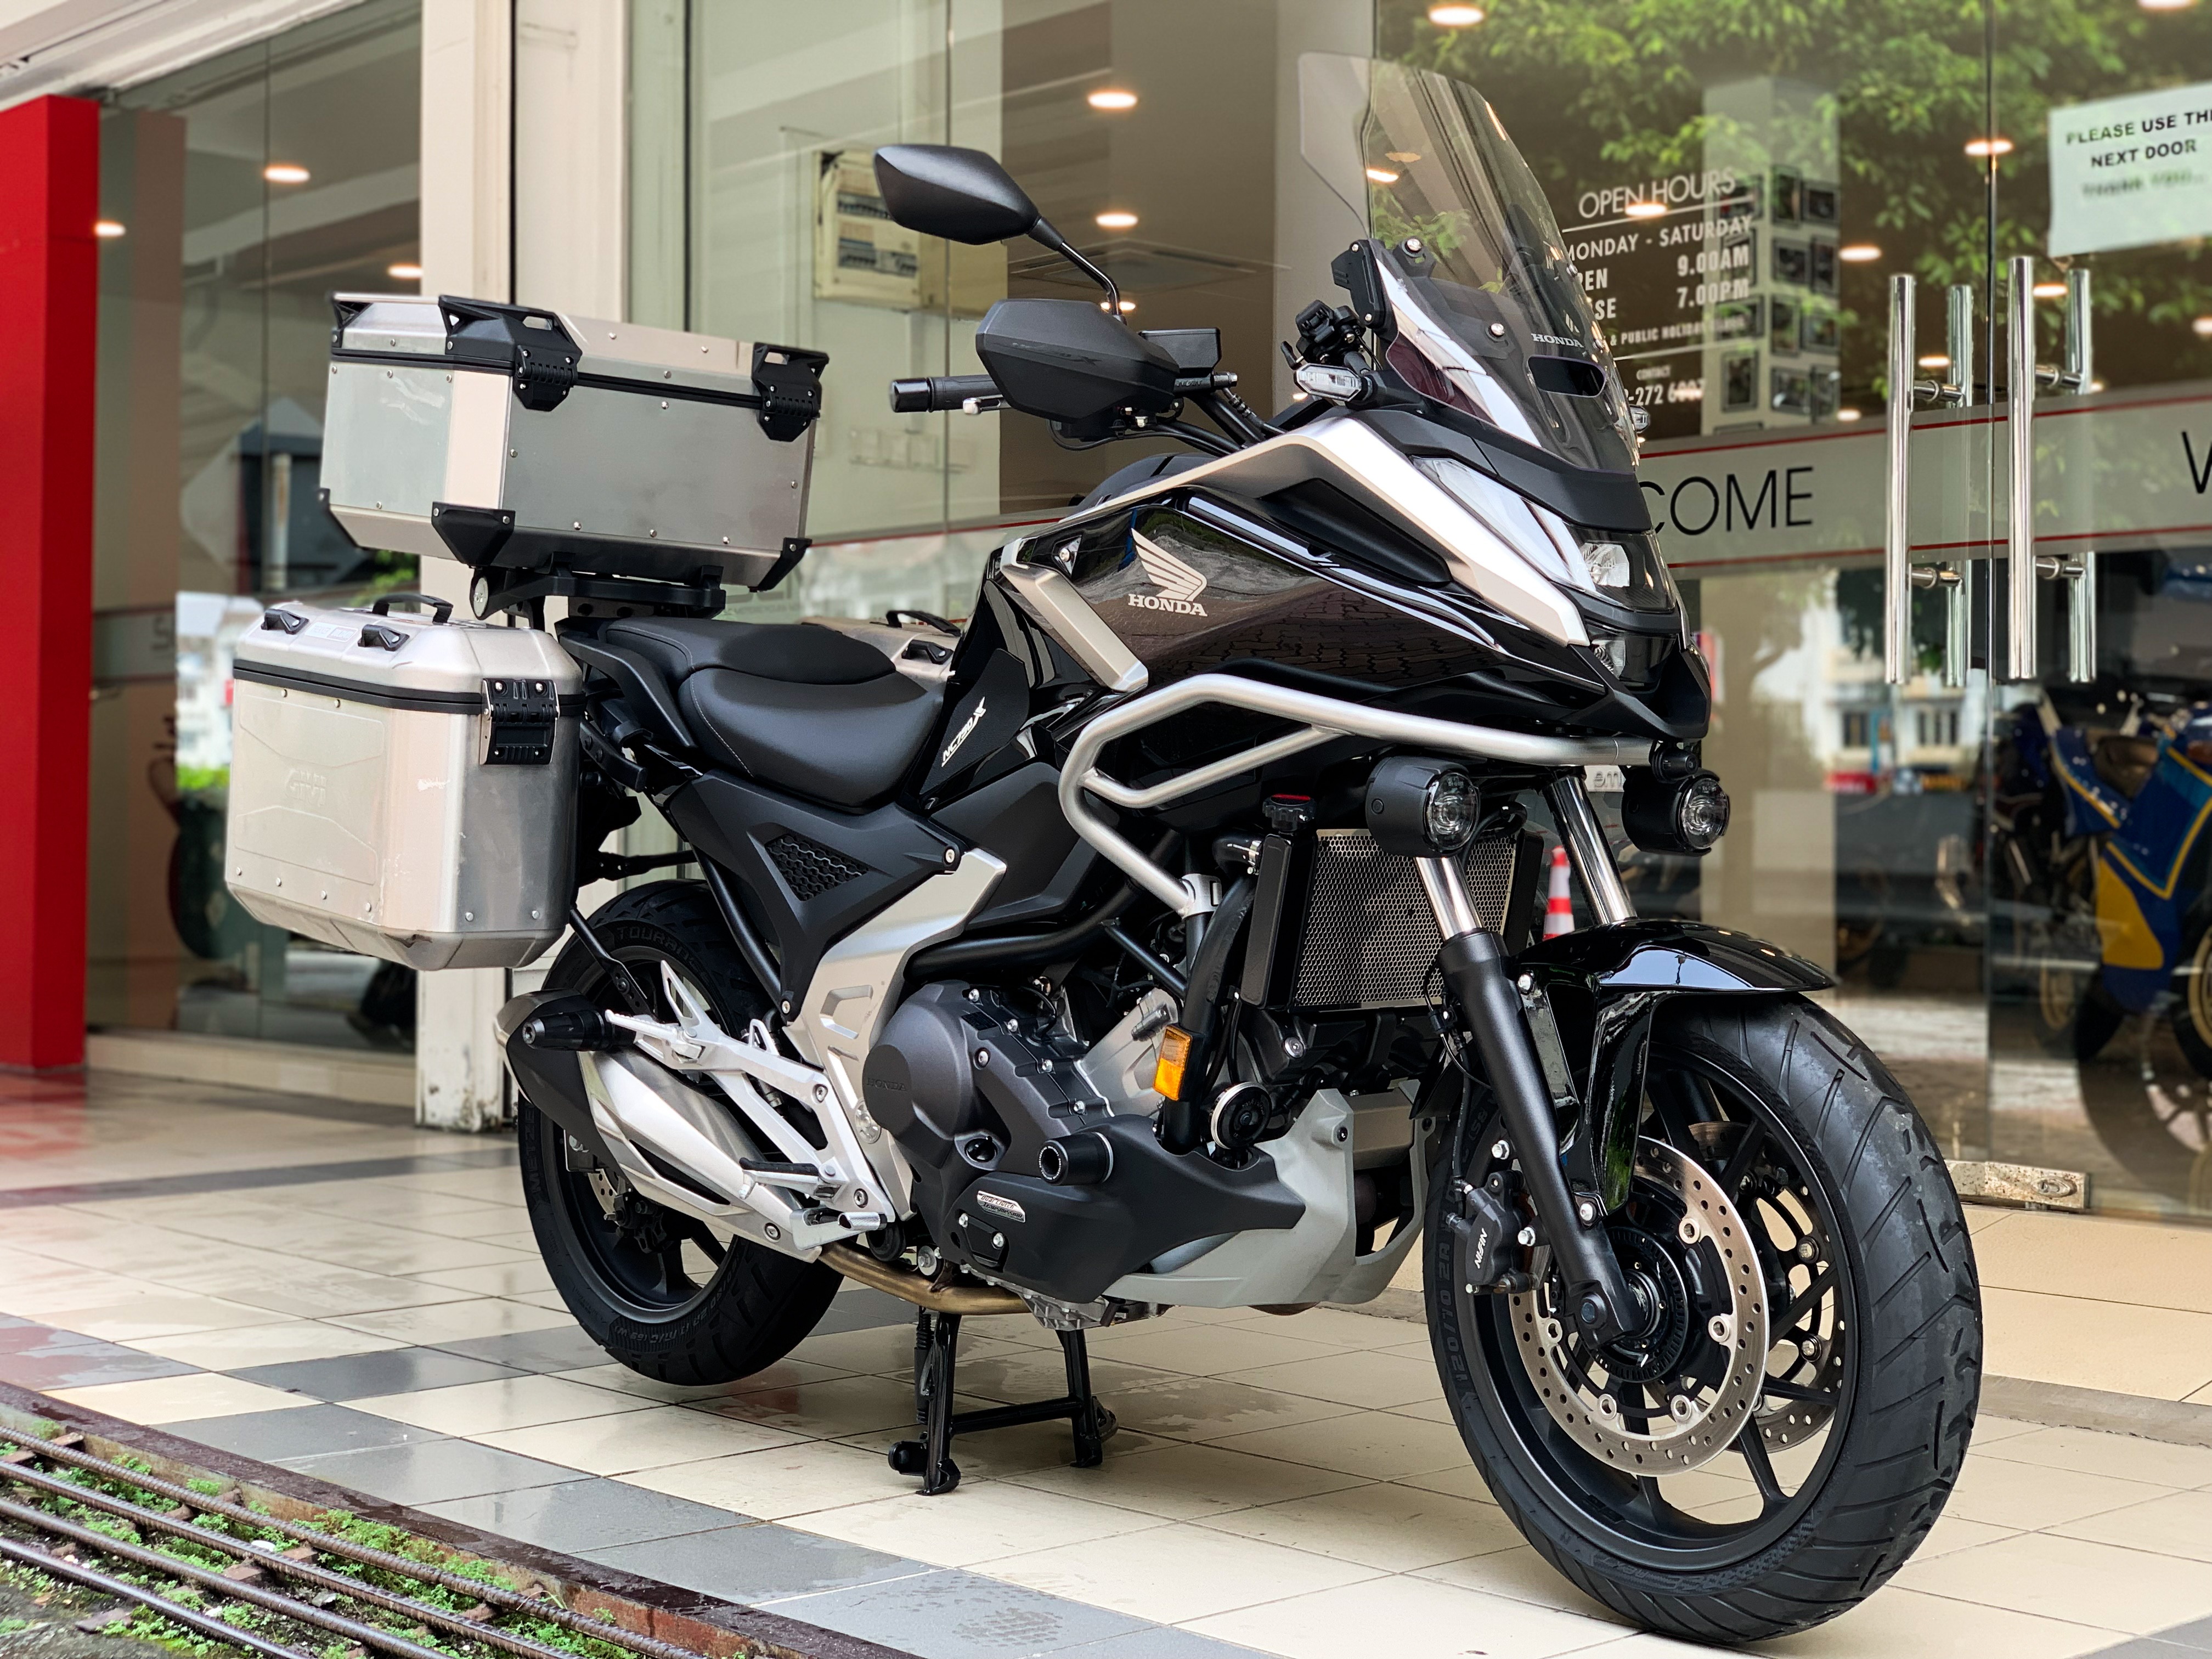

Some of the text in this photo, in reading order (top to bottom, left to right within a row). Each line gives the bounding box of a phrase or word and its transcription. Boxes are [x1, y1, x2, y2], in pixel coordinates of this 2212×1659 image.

[2066, 109, 2212, 145] PLEASE USE TH
[2091, 139, 2197, 168] NEXT DOOR
[1578, 166, 1736, 219] OPEN HOURS
[1659, 215, 1753, 247] SATURDAY
[1677, 245, 1749, 276] 9.00AM
[1677, 278, 1749, 309] 7.00PM
[1531, 333, 1584, 348] HONDA
[1639, 466, 1813, 536] COME
[1128, 594, 1208, 617] HONDA
[867, 1077, 906, 1091] HONDA
